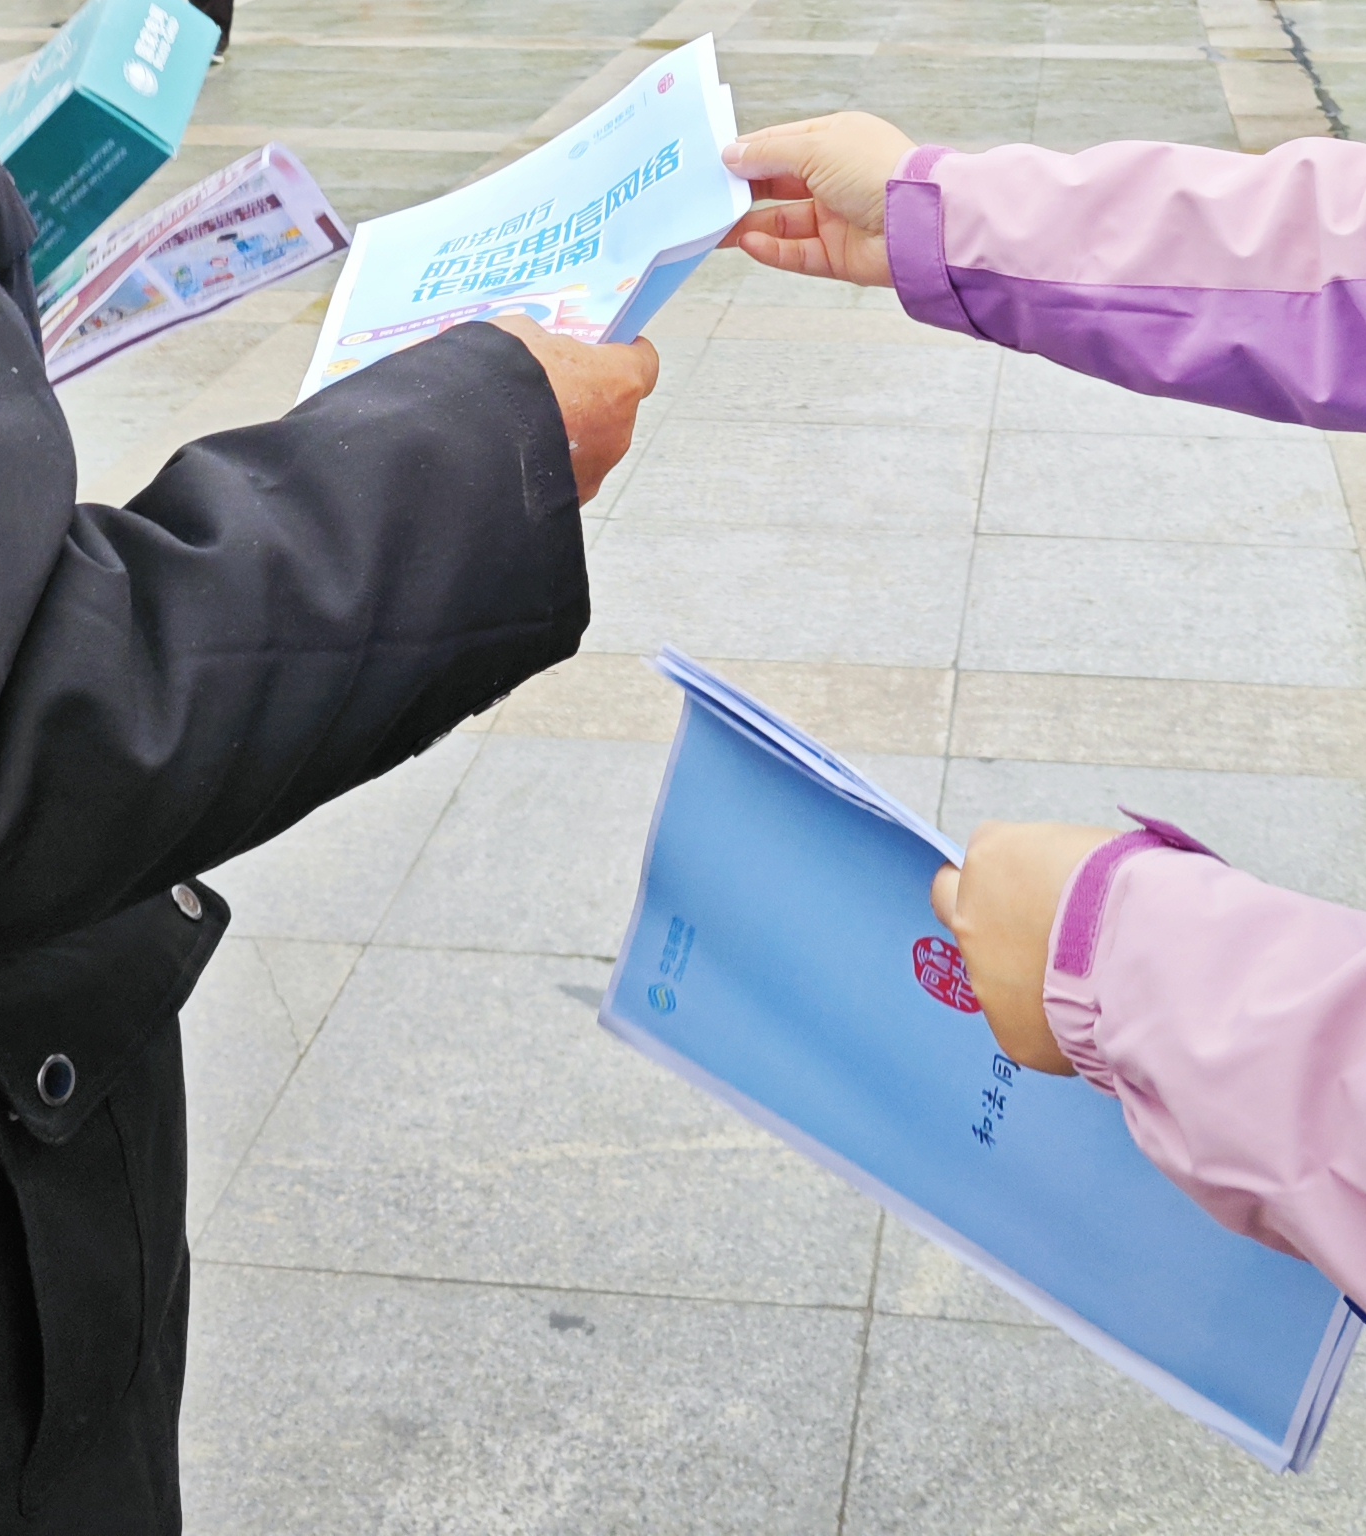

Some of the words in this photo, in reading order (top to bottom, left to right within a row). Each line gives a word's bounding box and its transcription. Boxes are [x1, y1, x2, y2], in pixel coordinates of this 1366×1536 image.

[421, 138, 683, 281] 防范电信网络
[434, 197, 557, 257] 和法同行
[411, 229, 604, 303] 诈骗指南
